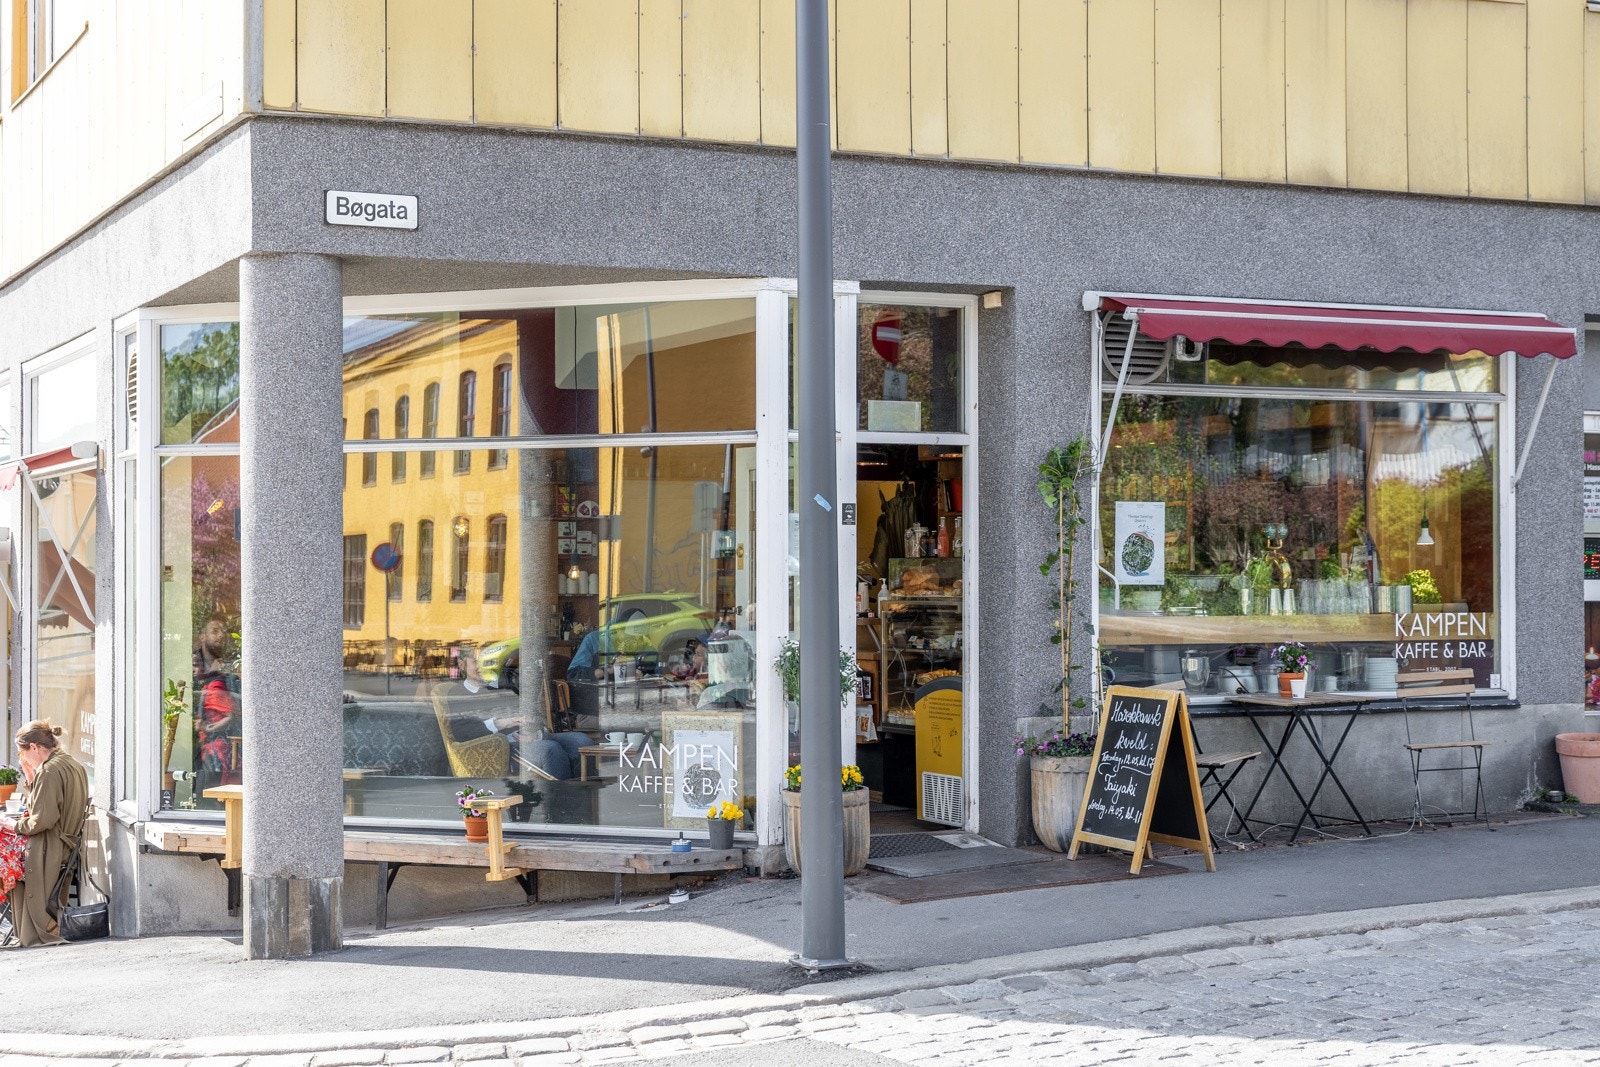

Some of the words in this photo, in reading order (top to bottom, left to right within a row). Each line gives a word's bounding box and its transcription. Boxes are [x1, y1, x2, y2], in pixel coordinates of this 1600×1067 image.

[336, 196, 408, 222] Bøgata
[1395, 612, 1486, 637] KAMPEN
[1395, 642, 1438, 659] KAFFE
[1443, 642, 1454, 658] &
[1459, 641, 1487, 658] BAR
[619, 741, 738, 771] KAMPEN
[619, 774, 674, 794] KAFFE
[682, 777, 694, 795] &
[702, 777, 738, 796] BAR
[1104, 773, 1138, 805] Taiyaki
